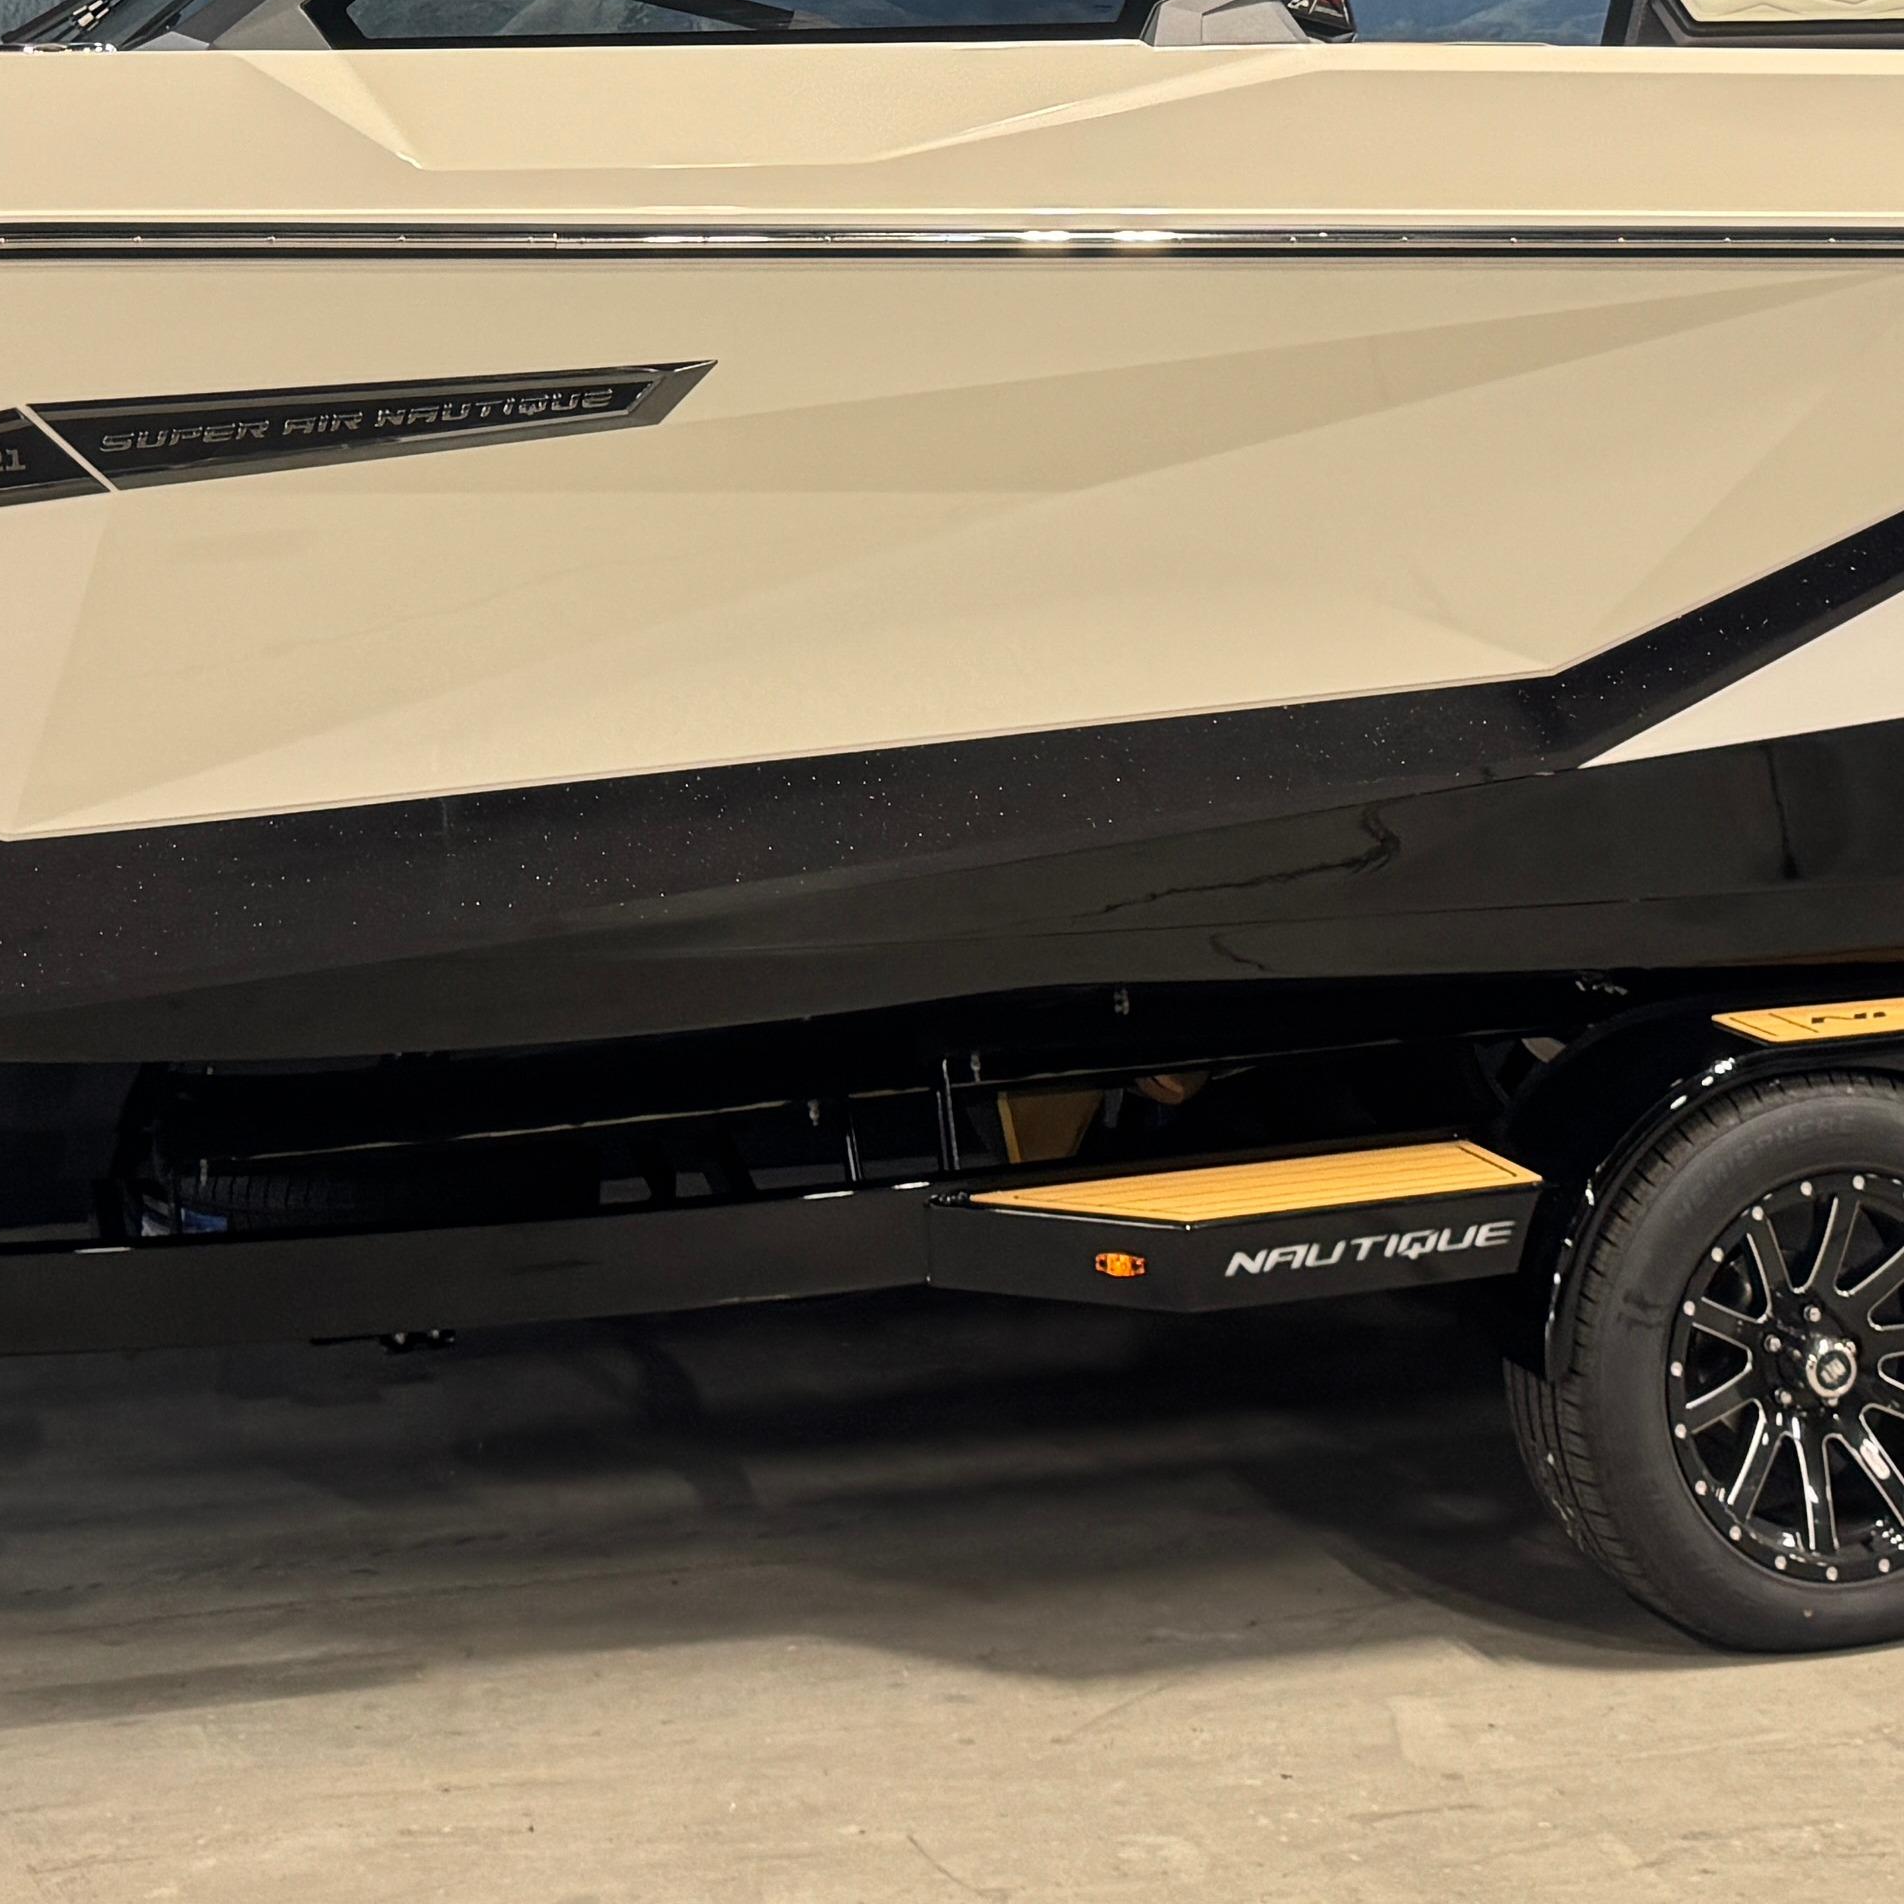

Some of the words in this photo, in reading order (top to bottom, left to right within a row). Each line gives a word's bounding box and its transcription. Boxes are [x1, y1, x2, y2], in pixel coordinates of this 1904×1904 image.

[98, 419, 271, 453] SUPER
[282, 410, 364, 436] AIR
[374, 387, 615, 429] NAUTIQUE
[1225, 1221, 1516, 1277] NAUTIQUE
